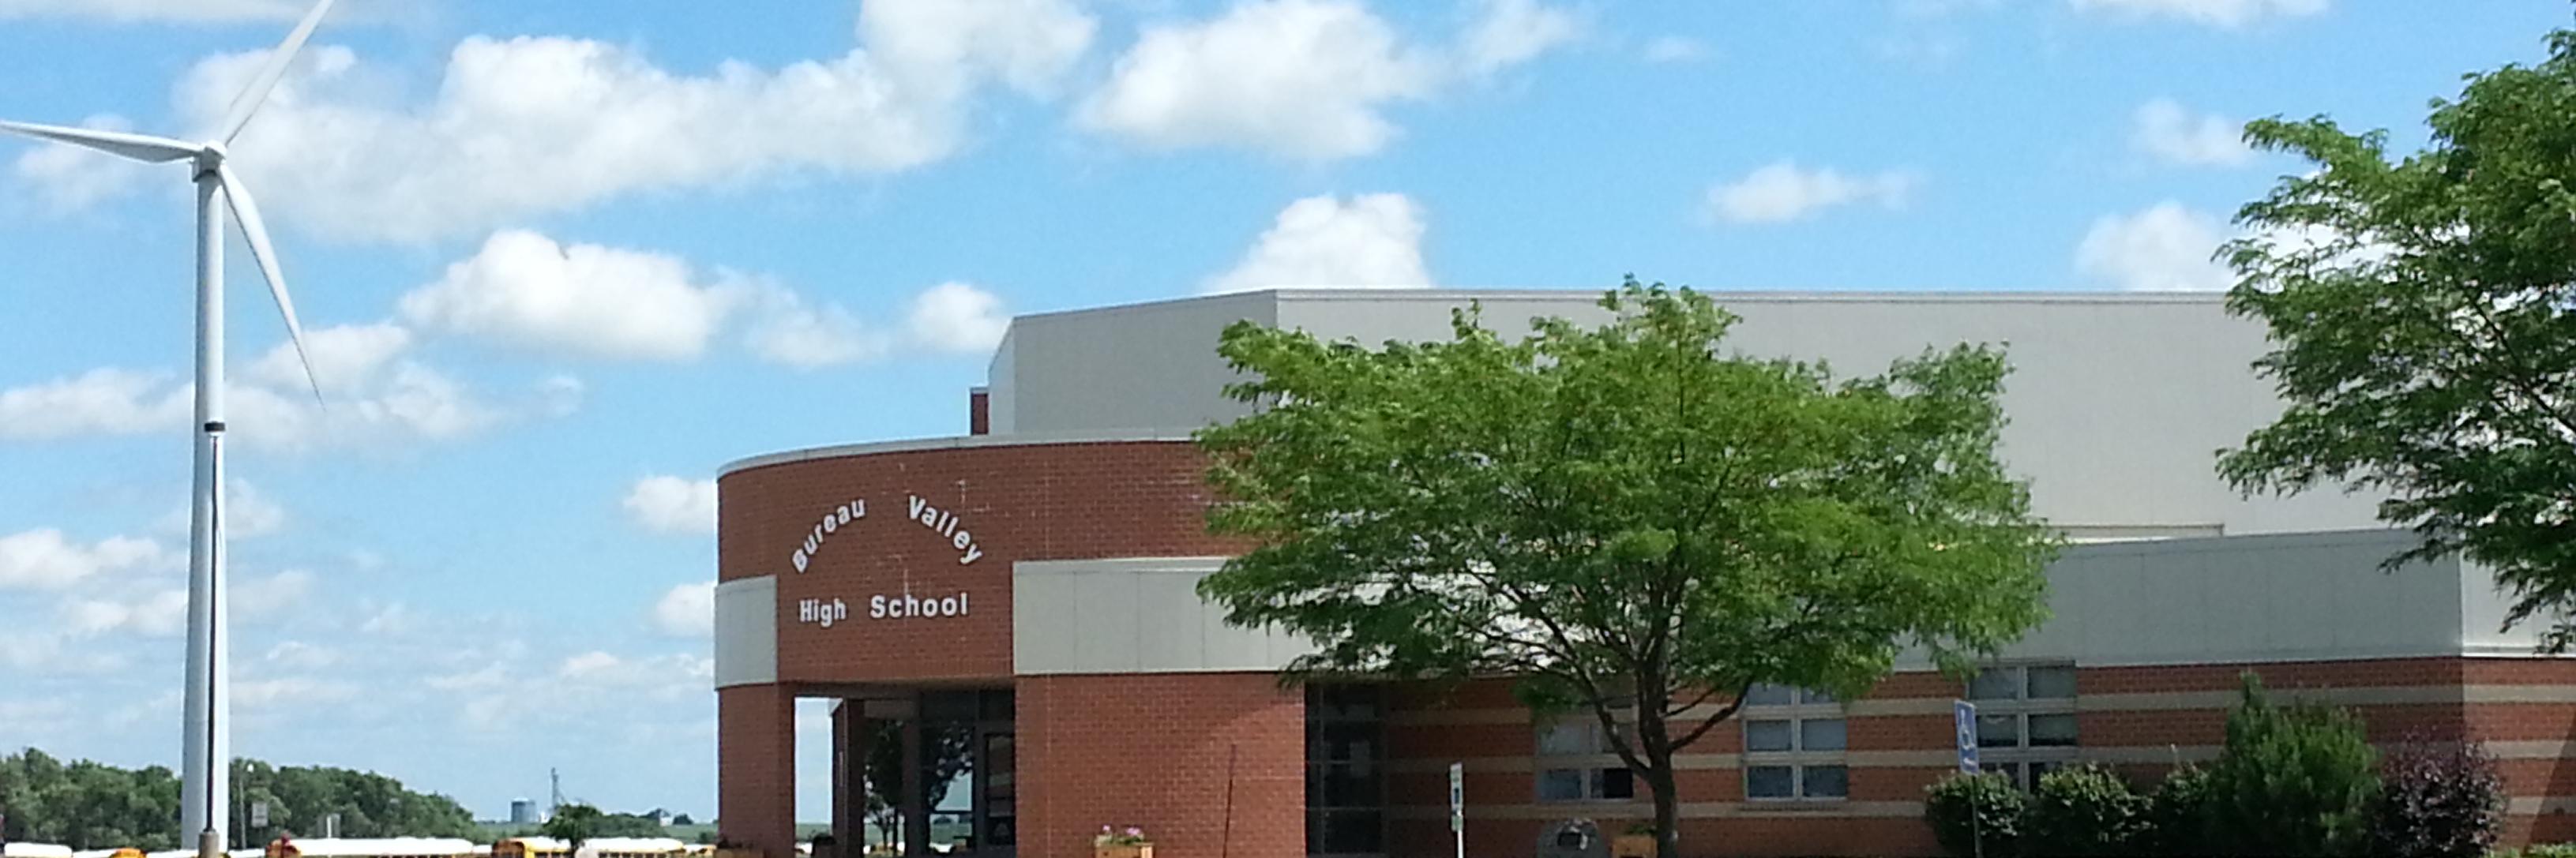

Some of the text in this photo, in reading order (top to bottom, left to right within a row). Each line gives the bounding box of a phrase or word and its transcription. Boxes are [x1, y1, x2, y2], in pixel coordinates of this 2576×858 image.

[792, 495, 982, 573] Bureau Valley
[799, 592, 967, 628] High School
